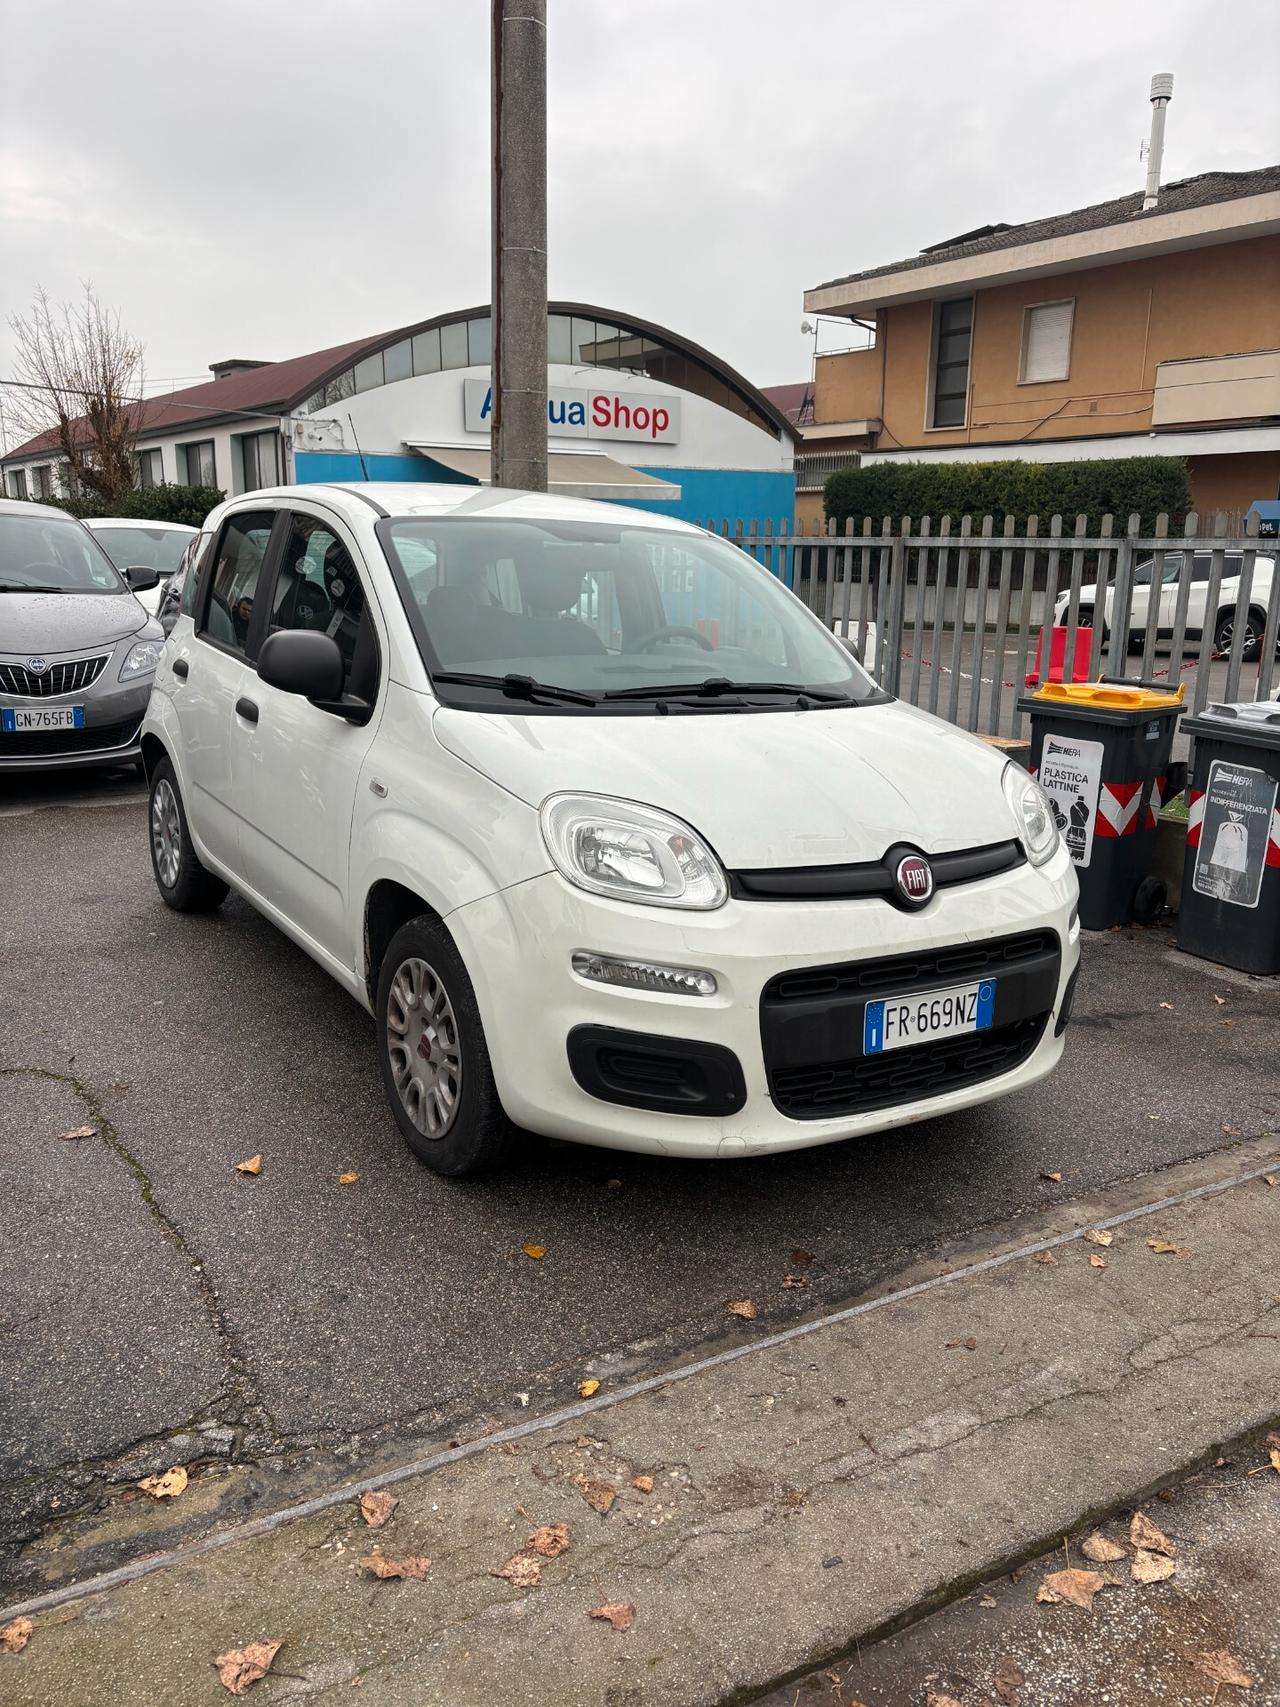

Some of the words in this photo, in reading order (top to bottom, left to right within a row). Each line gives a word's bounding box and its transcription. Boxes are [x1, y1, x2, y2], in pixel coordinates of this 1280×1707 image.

[1044, 767, 1089, 784] PLASTICA
[1231, 774, 1253, 788] HERA
[1043, 778, 1080, 793] LATTINE
[1210, 795, 1268, 816] INDIFFERENZIATA
[905, 868, 927, 890] FIAT
